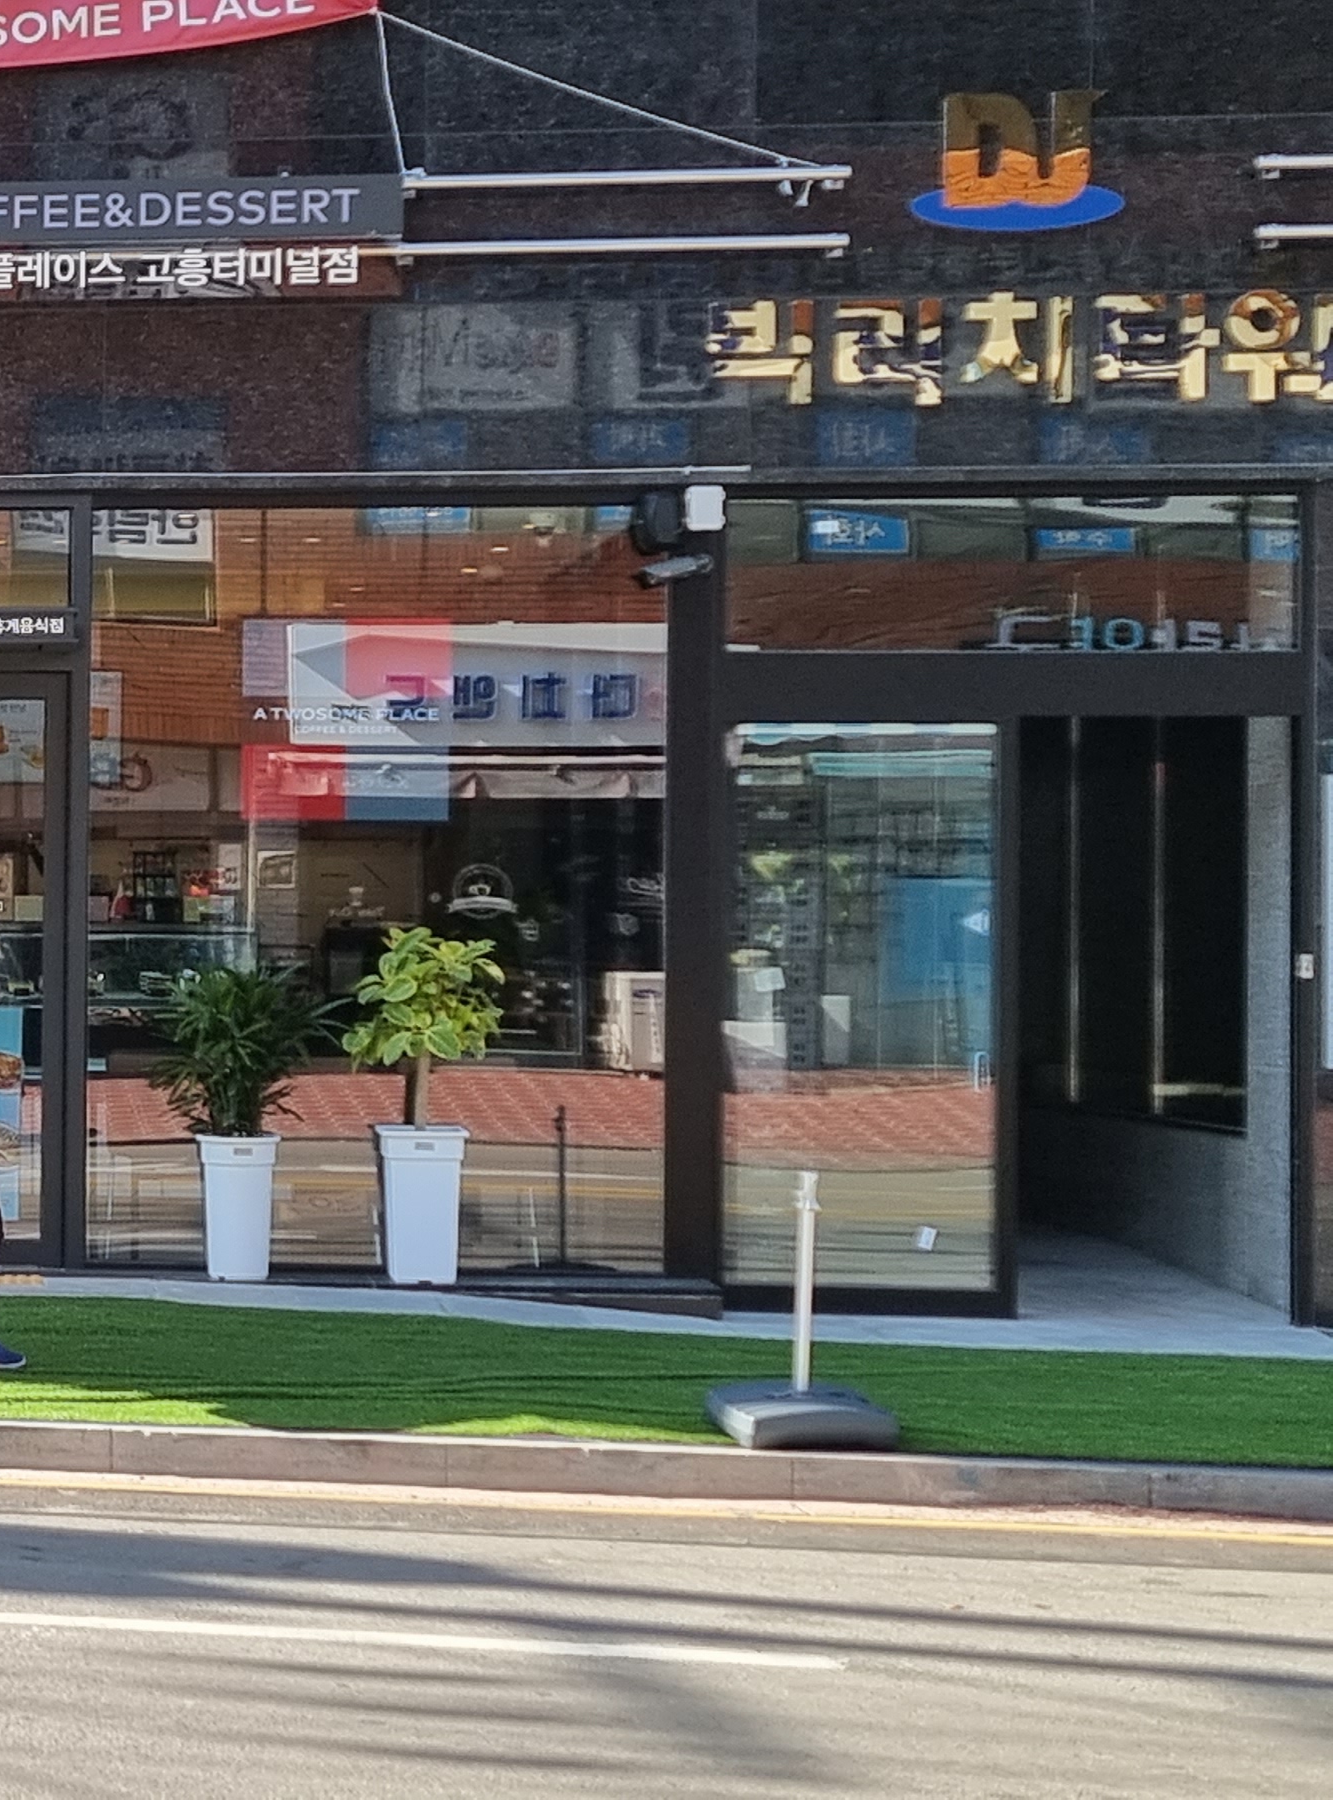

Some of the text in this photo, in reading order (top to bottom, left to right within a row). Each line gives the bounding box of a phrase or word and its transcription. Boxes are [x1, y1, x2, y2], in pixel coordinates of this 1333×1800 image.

[135, 243, 361, 288] 고흥터미널점
[252, 706, 440, 723] A TWOSOME PLACE
